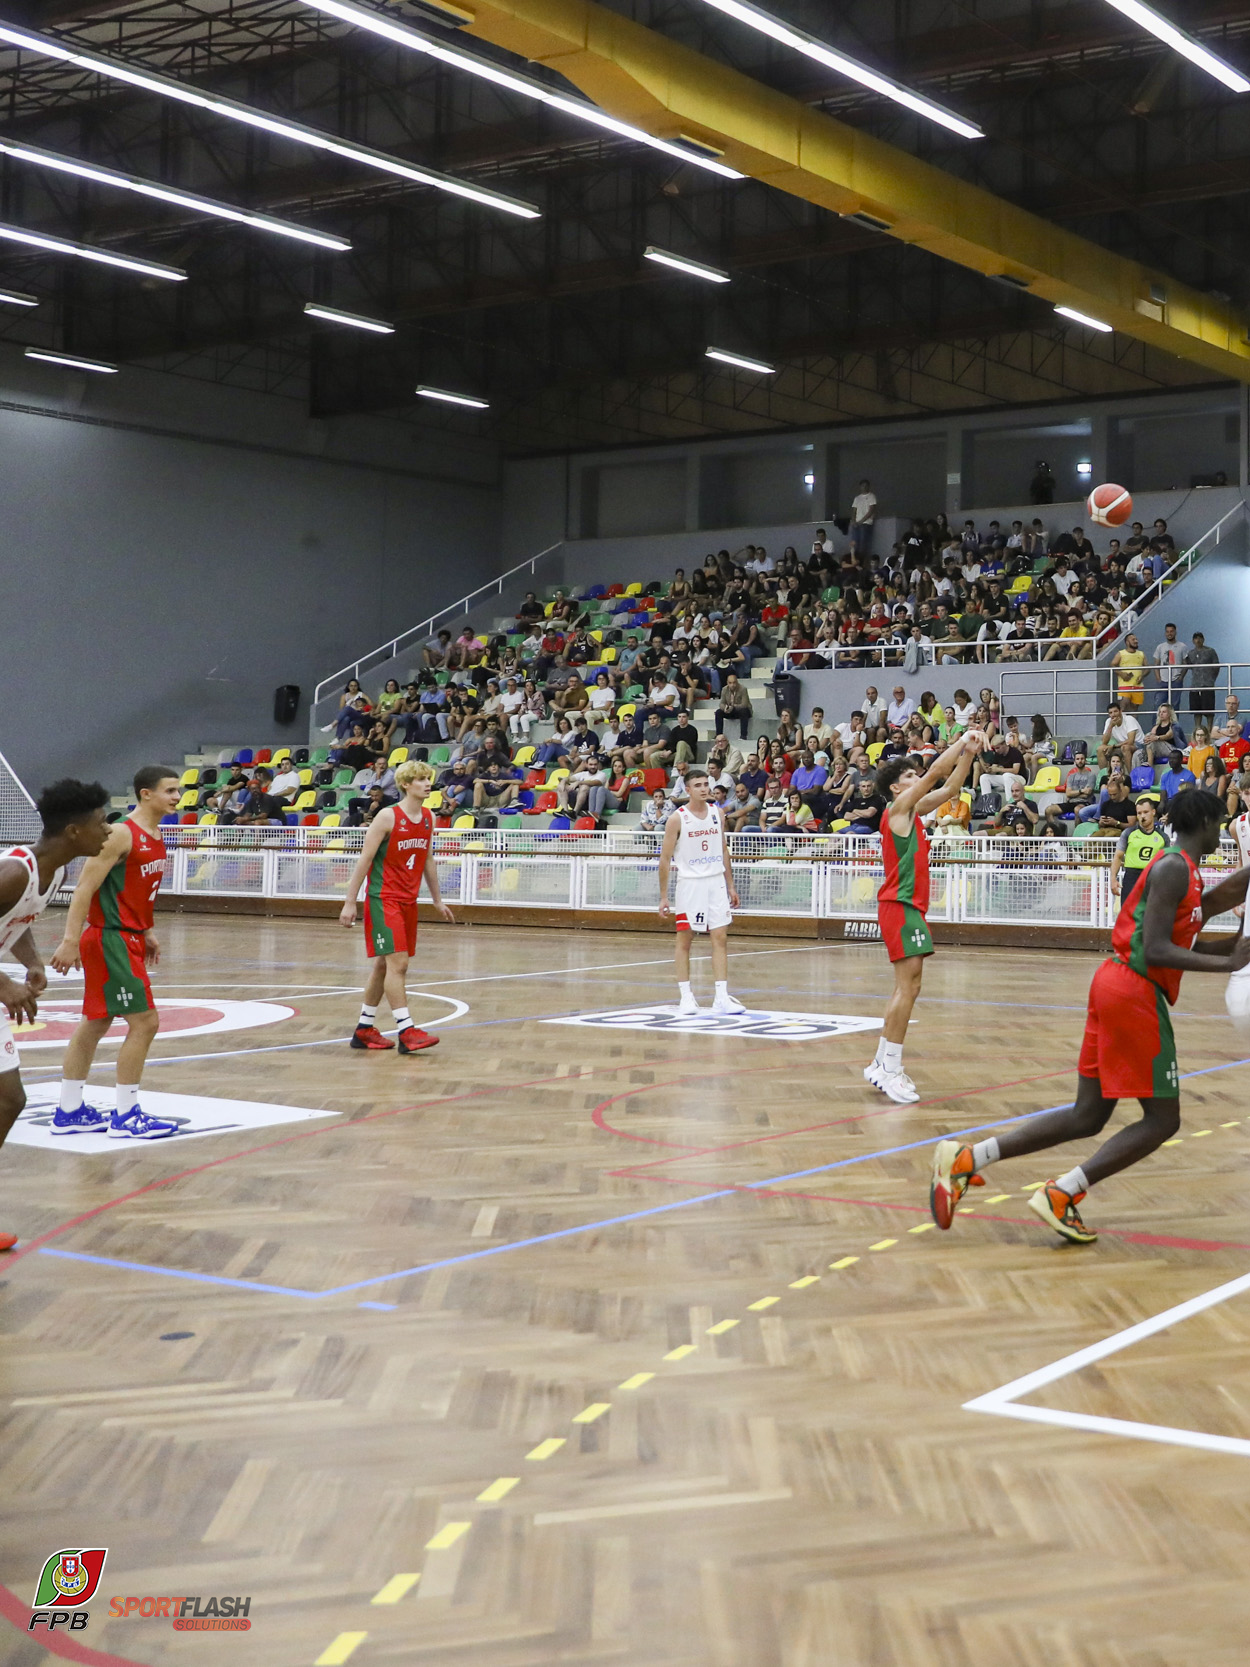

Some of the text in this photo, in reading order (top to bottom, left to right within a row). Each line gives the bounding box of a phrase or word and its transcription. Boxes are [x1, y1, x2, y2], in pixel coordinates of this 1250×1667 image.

[688, 828, 719, 838] ESPAÑA
[701, 840, 709, 852] 6
[405, 853, 416, 870] 4
